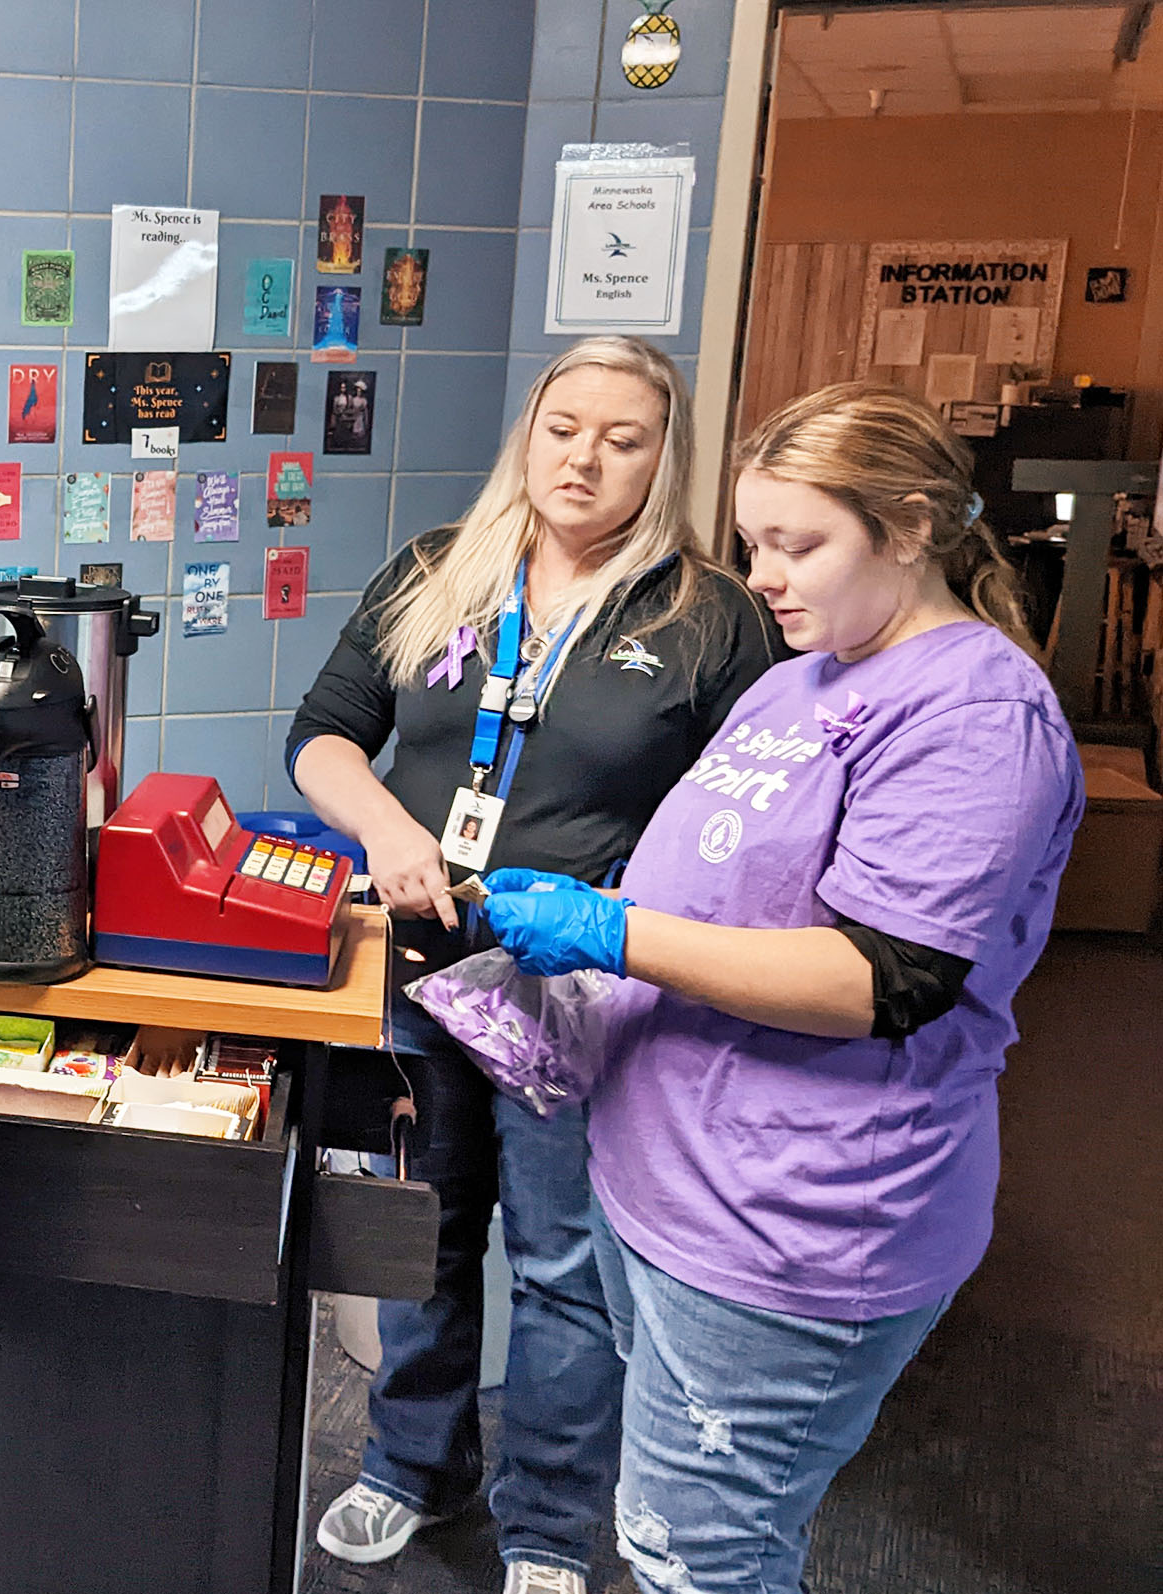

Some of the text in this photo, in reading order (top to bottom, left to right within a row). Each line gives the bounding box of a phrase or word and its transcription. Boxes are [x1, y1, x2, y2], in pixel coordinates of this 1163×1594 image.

[592, 185, 653, 196] Minnewaska
[588, 200, 656, 210] Area Schools
[131, 209, 202, 226] Ms. Spence is
[326, 213, 356, 224] CITY
[880, 262, 1048, 283] INFORMATION
[582, 273, 649, 285] Ms. Spence
[596, 289, 632, 300] English
[901, 285, 1011, 305] STATION
[11, 368, 56, 384] DRY
[133, 385, 153, 395] This
[130, 397, 183, 409] Ms. Spence
[137, 408, 176, 418] has read
[141, 434, 176, 456] 7 books
[188, 565, 216, 576] ONE
[204, 578, 221, 588] BY
[195, 591, 225, 603] ONE
